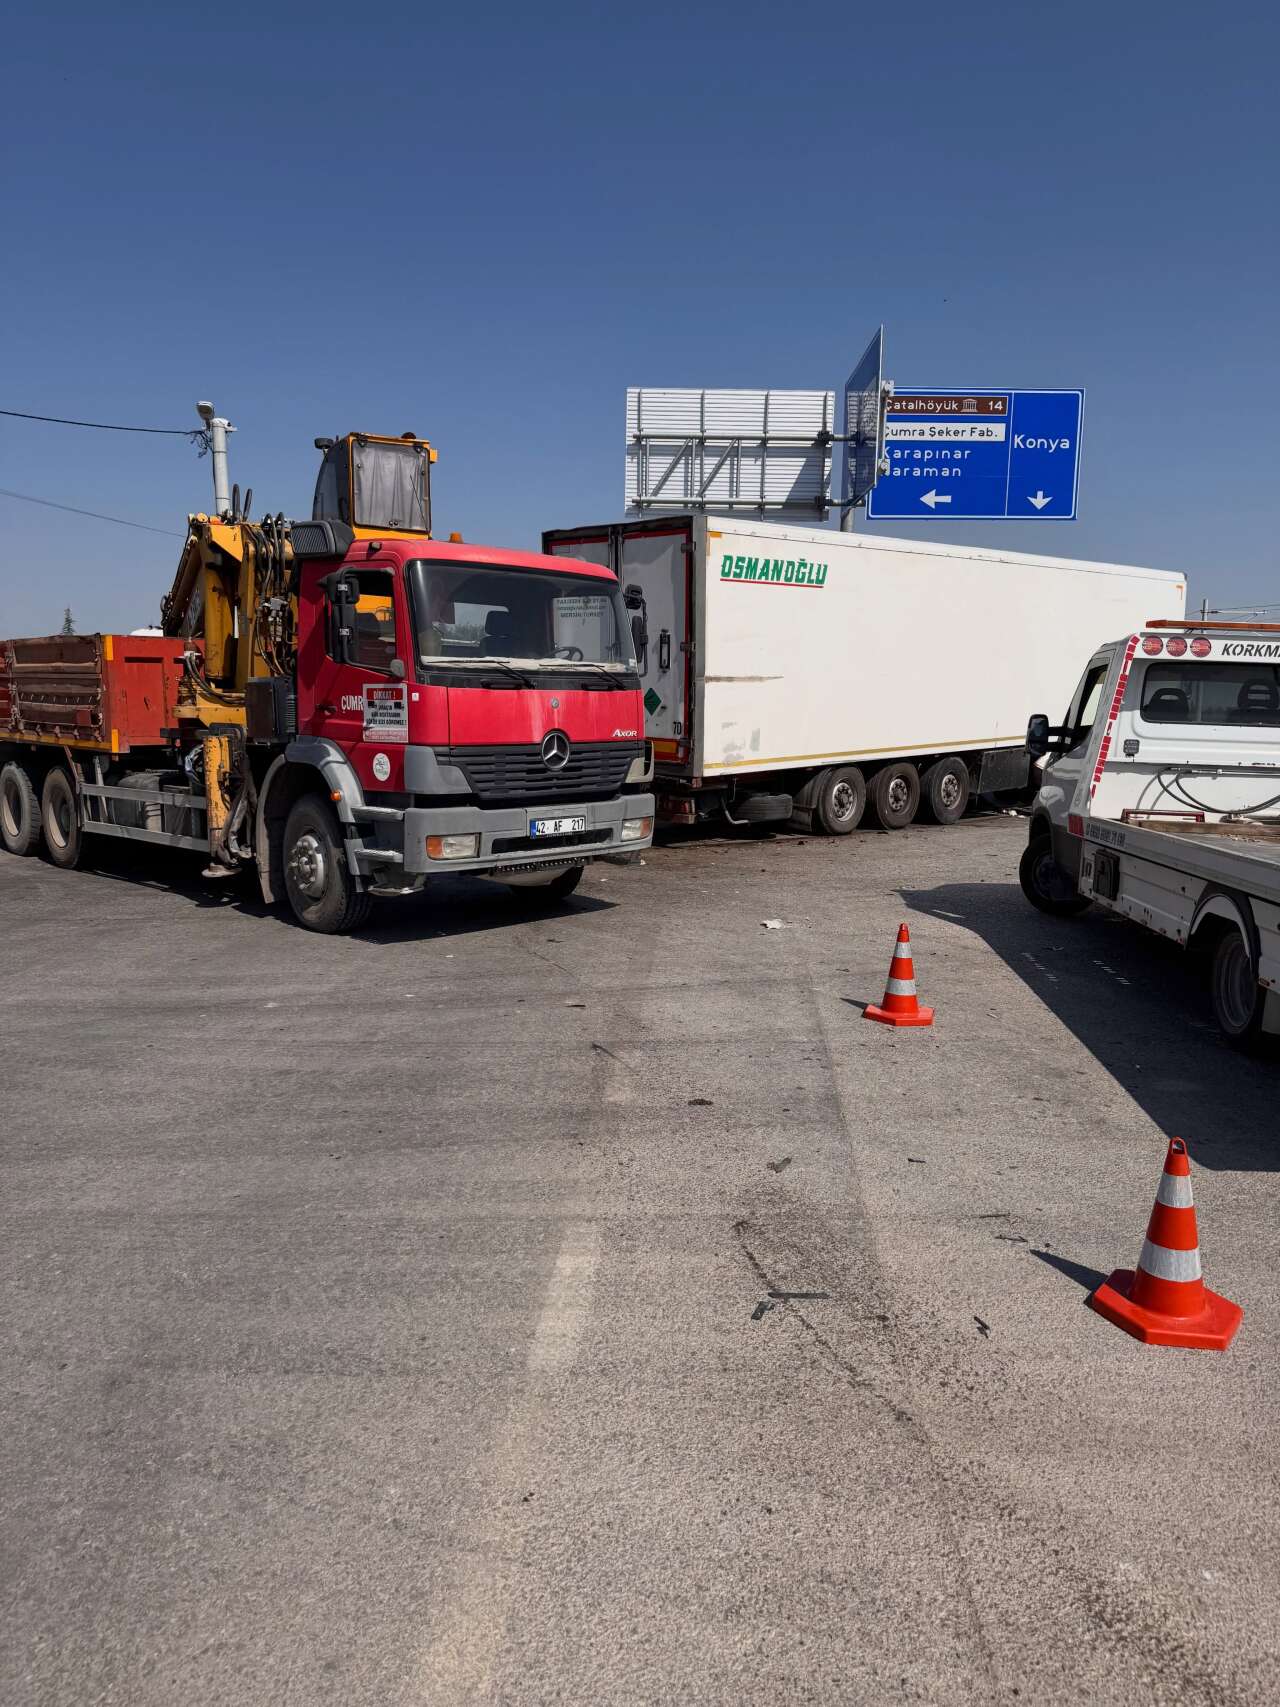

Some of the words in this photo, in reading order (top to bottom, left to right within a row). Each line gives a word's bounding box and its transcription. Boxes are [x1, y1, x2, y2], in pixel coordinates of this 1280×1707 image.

[885, 398, 959, 413] Çatalhöyük
[988, 400, 1004, 411] 14
[929, 426, 967, 438] Şeker
[970, 427, 998, 438] Fab.
[1013, 434, 1070, 453] Konya
[720, 554, 828, 585] OSMANOĞLU
[341, 695, 364, 713] ÇUMR
[673, 721, 682, 735] 70
[536, 821, 546, 834] 42
[553, 820, 563, 832] AF
[571, 818, 584, 831] 217
